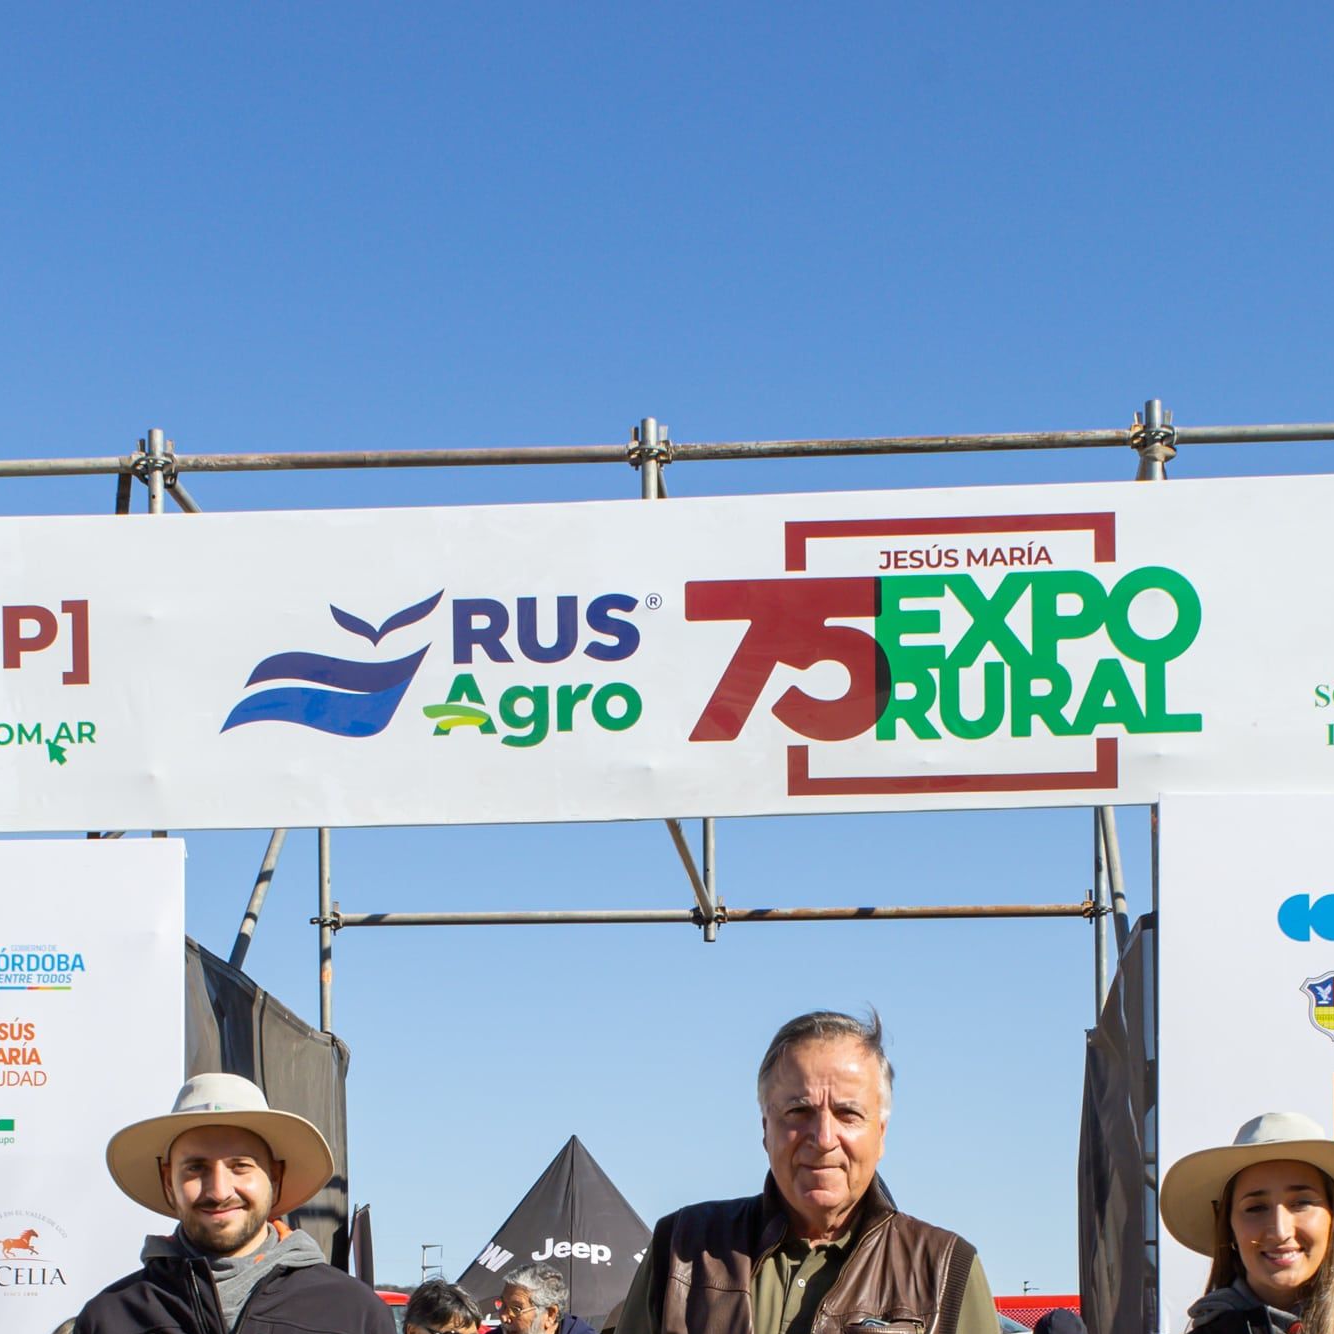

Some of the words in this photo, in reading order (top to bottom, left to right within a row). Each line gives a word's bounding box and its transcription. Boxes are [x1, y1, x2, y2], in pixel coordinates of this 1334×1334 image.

[879, 545, 959, 571] JESÚS
[966, 541, 1054, 568] MARÍA
[875, 565, 1202, 667] EXPO
[684, 576, 892, 742] 75
[422, 673, 643, 748] Agro
[875, 658, 1202, 742] RURAL
[37, 974, 72, 984] TODOS
[531, 1238, 612, 1264] Jeep
